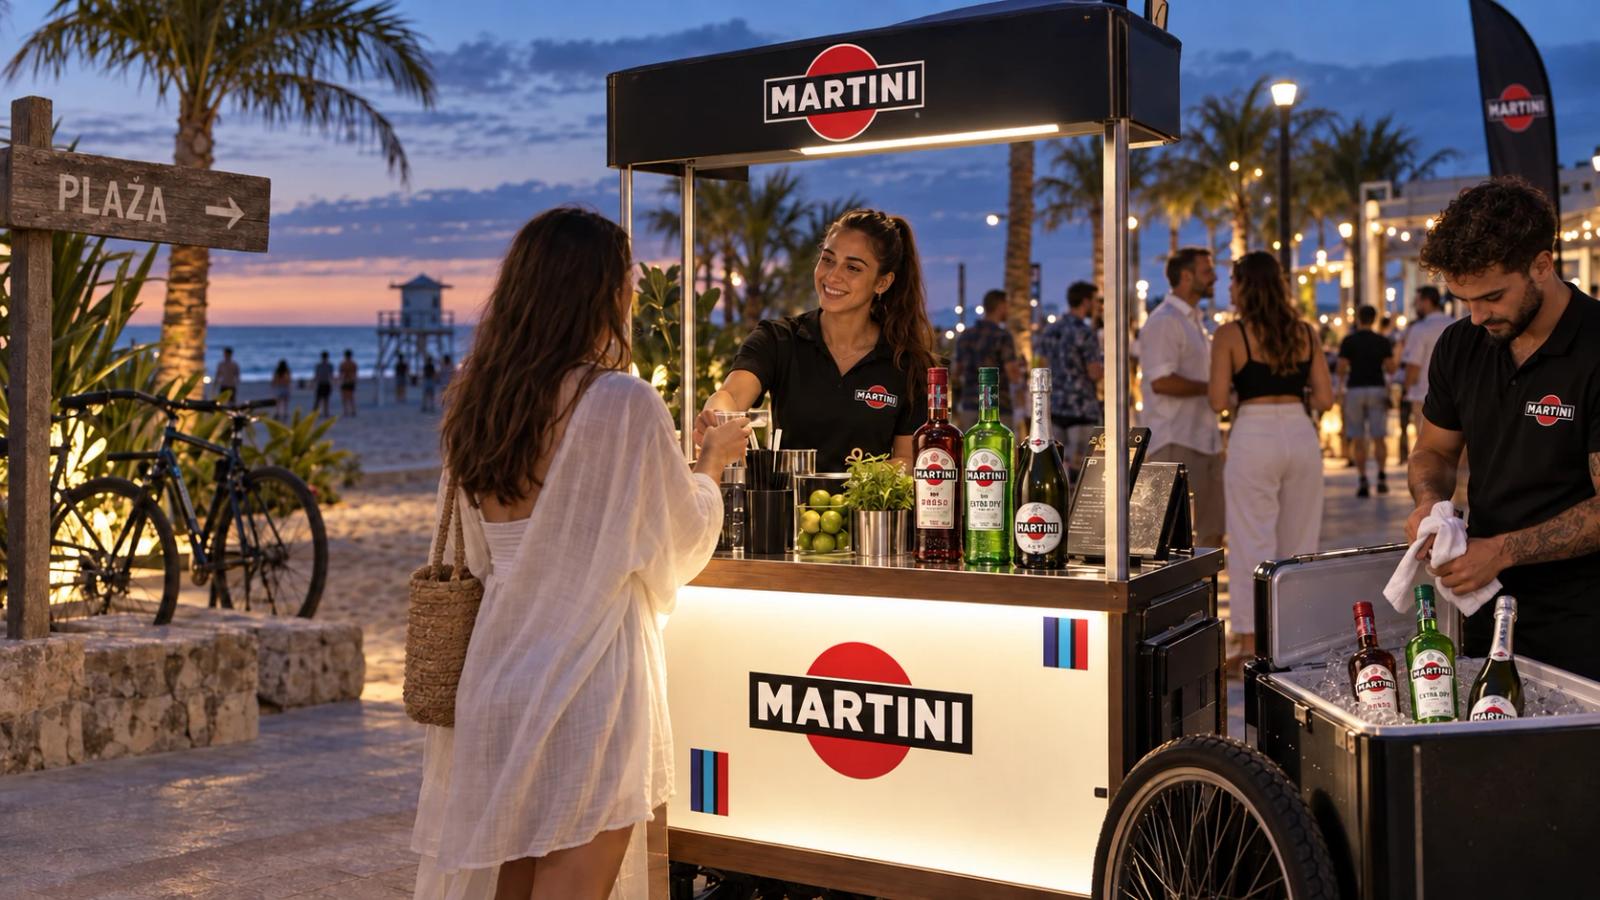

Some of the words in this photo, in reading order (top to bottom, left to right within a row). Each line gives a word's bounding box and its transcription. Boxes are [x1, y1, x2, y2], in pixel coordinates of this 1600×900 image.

[771, 70, 916, 115] MARTINI
[1488, 99, 1545, 117] MARTINI
[58, 173, 167, 224] PLAŽA
[857, 391, 896, 405] MARTINI
[1527, 404, 1572, 418] MARTINI
[916, 470, 955, 479] MARTINI
[967, 471, 1005, 480] MARTINI
[1017, 523, 1058, 533] MARTINI
[757, 681, 964, 745] MARTINI
